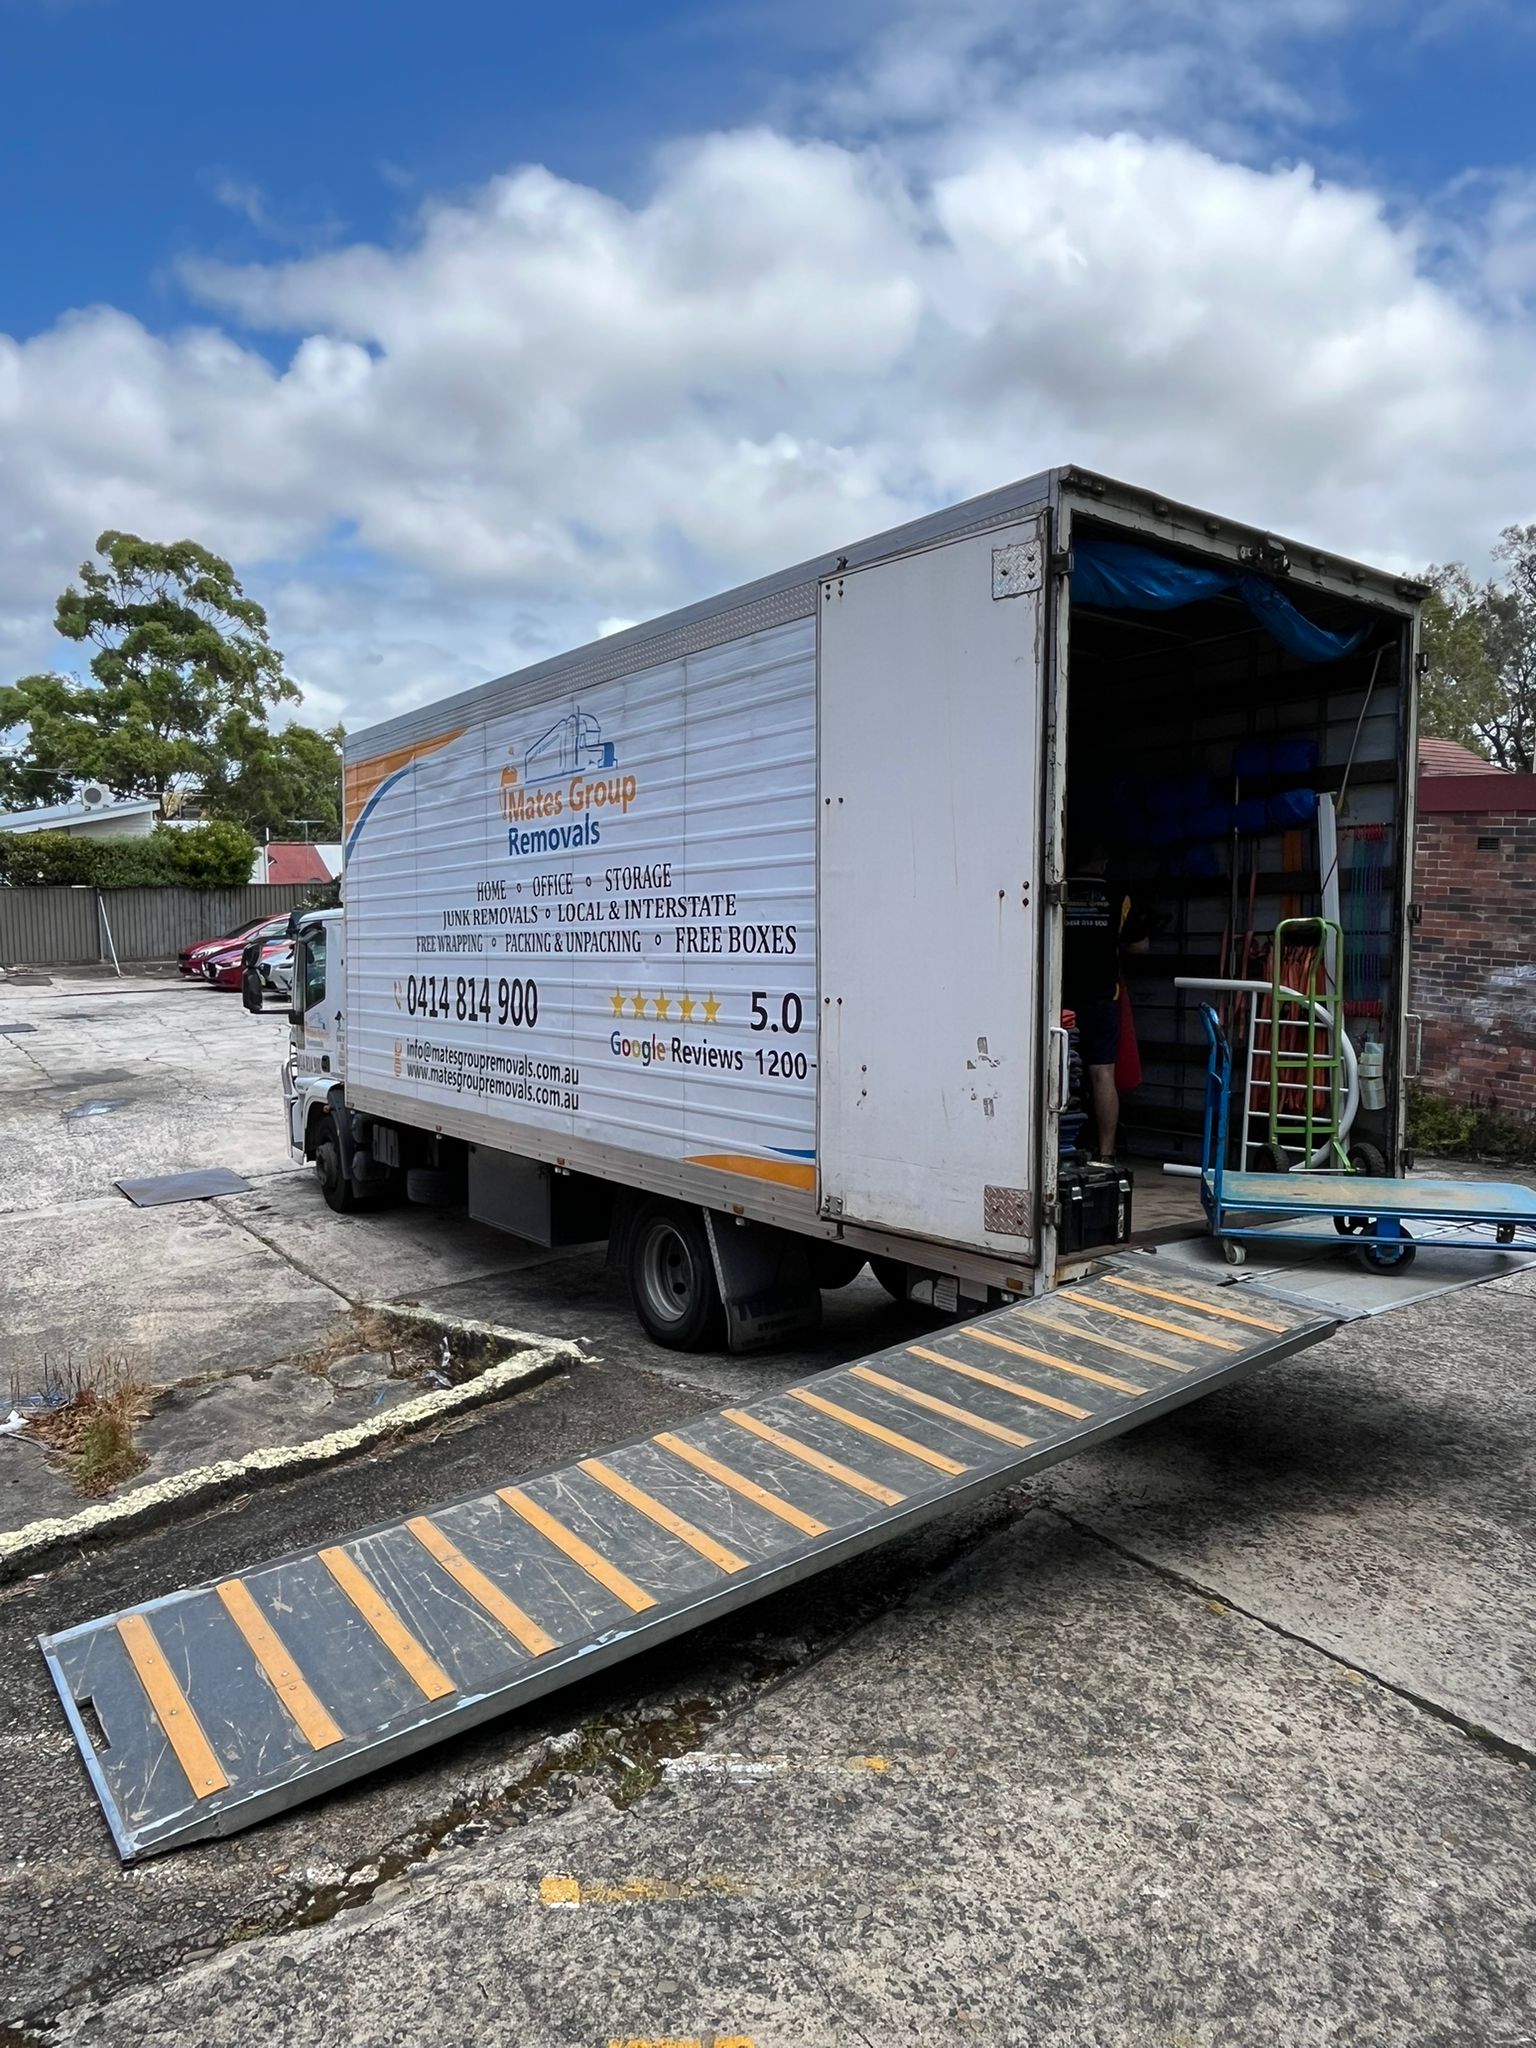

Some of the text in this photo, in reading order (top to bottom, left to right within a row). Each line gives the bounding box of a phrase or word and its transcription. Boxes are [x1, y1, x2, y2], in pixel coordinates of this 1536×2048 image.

[508, 775, 637, 823] Mates Group
[508, 813, 600, 856] Removals
[477, 863, 672, 901] HOME OFFICE STORAGE
[443, 894, 737, 930] JUNK REMOVALS LOCAL & INTERSTATE
[416, 925, 797, 954] FREE WRAPPING PACKING & UNPACKING FREE BOXES
[407, 975, 538, 1028] 0414 814 900
[750, 991, 803, 1034] 5.0
[406, 1038, 579, 1085] info@matesgroupremovals.com.au
[610, 1031, 666, 1066] Google
[671, 1037, 743, 1070] Reviews
[406, 1063, 579, 1110] www.matesgroupremovals.com.au
